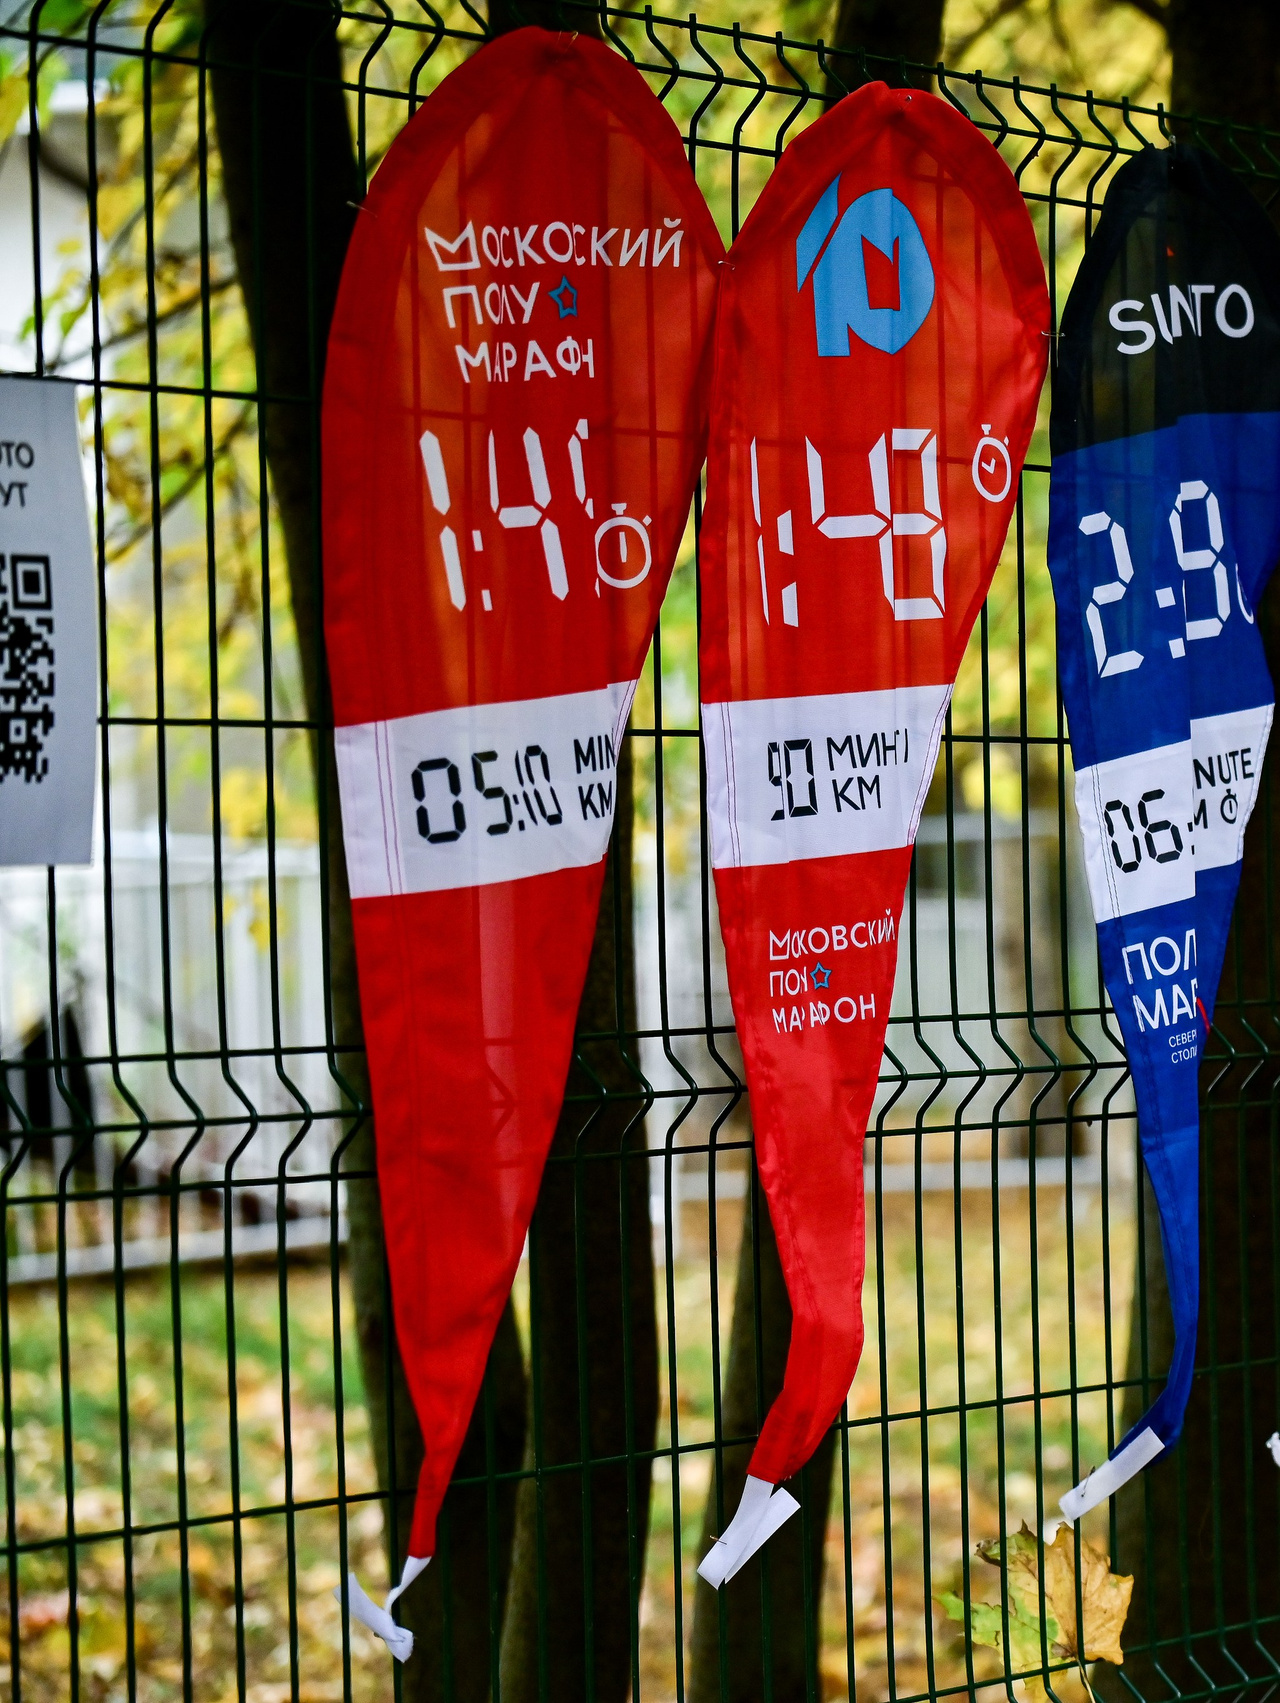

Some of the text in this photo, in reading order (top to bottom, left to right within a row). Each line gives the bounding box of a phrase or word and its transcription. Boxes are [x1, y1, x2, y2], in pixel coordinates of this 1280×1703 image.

[0, 441, 35, 469] ТО
[577, 780, 613, 821] KM
[831, 774, 882, 813] КМ
